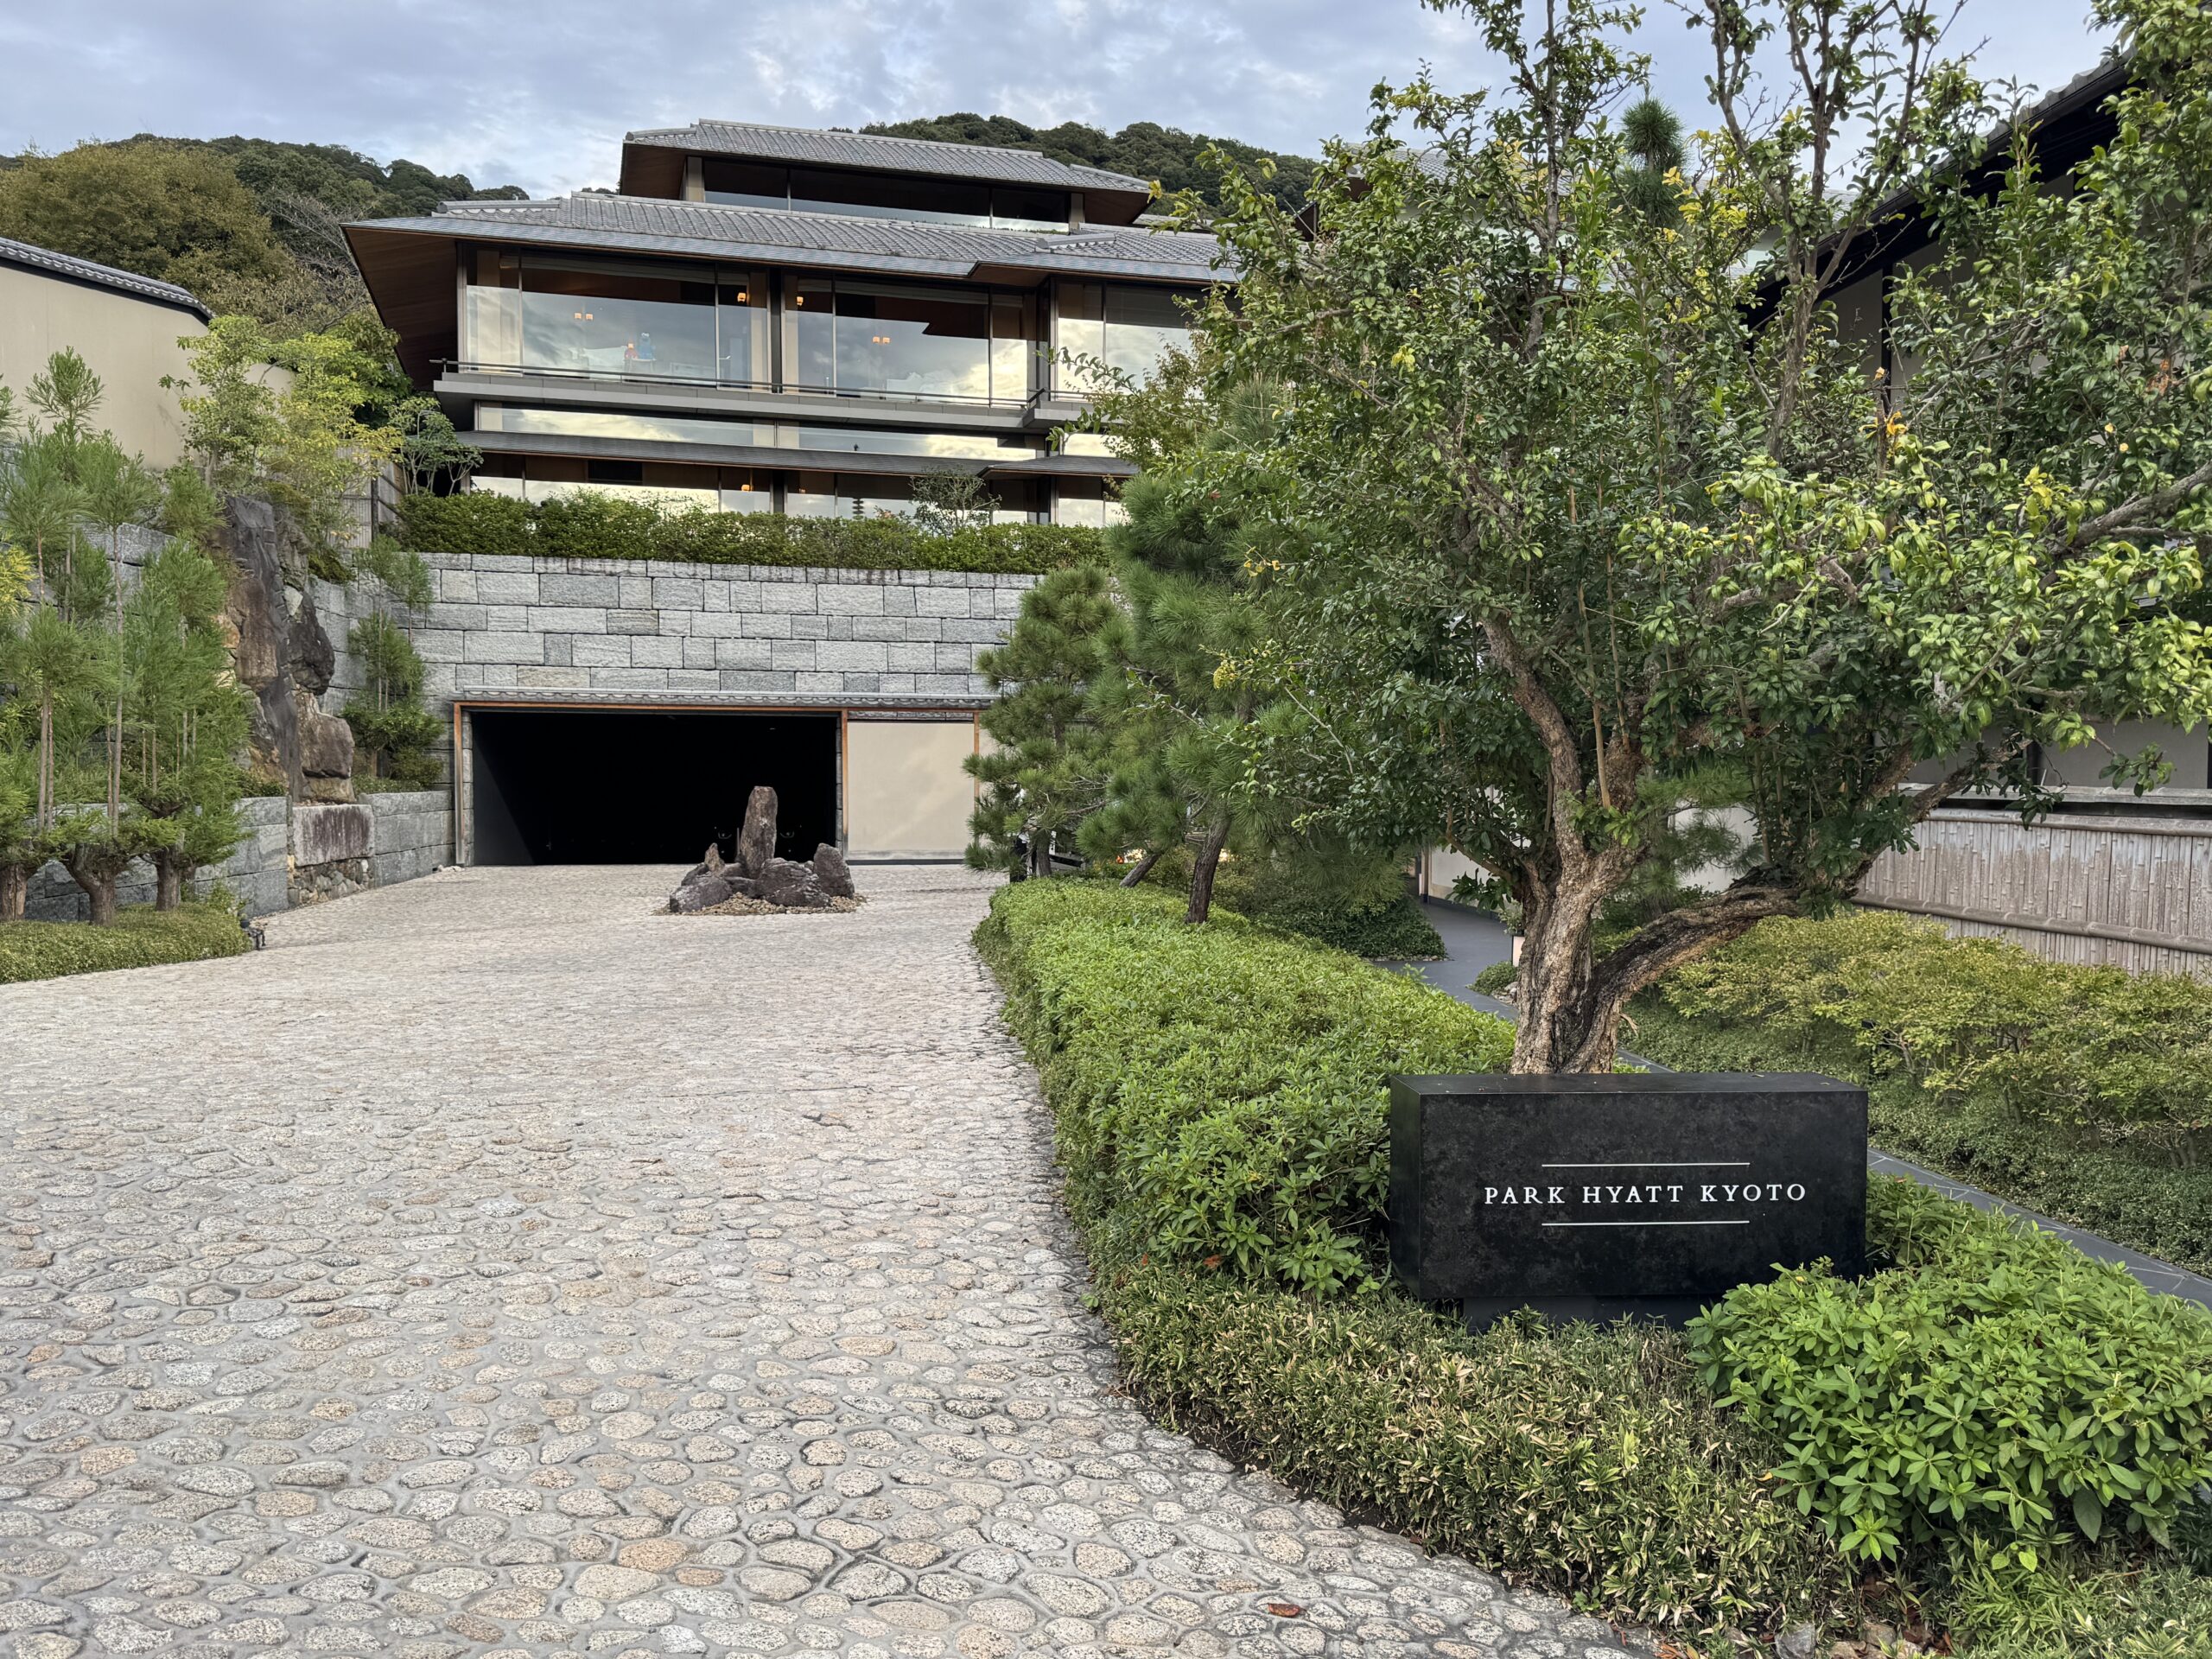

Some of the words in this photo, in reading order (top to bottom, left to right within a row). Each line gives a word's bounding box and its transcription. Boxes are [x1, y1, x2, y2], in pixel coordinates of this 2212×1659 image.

[1484, 1185, 1566, 1205] PARK
[1582, 1185, 1684, 1204] HYATT
[1700, 1183, 1807, 1203] KYOTO
